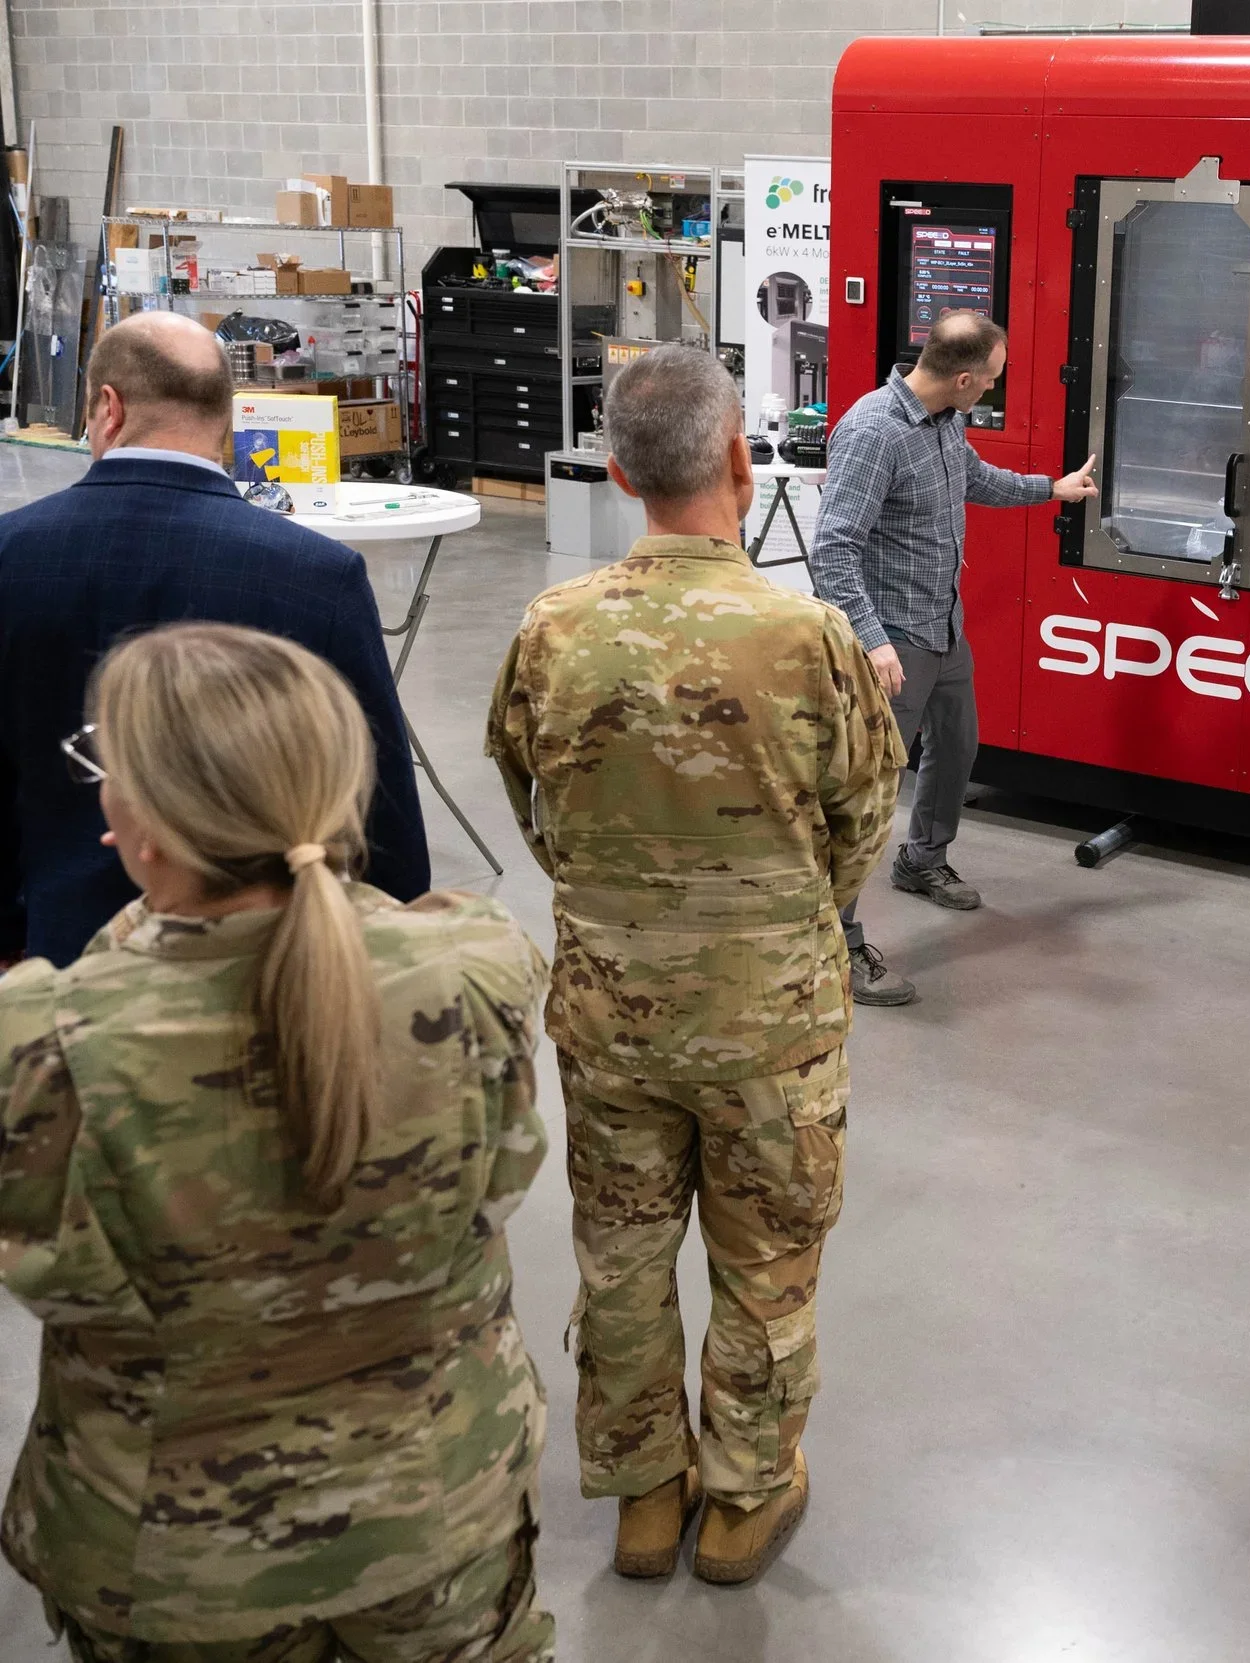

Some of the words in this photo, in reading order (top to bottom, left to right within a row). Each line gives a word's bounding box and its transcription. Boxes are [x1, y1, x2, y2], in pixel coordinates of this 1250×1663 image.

[766, 246, 790, 257] 6kW
[793, 248, 799, 257] x
[802, 247, 809, 256] 4
[344, 426, 377, 437] Leybold
